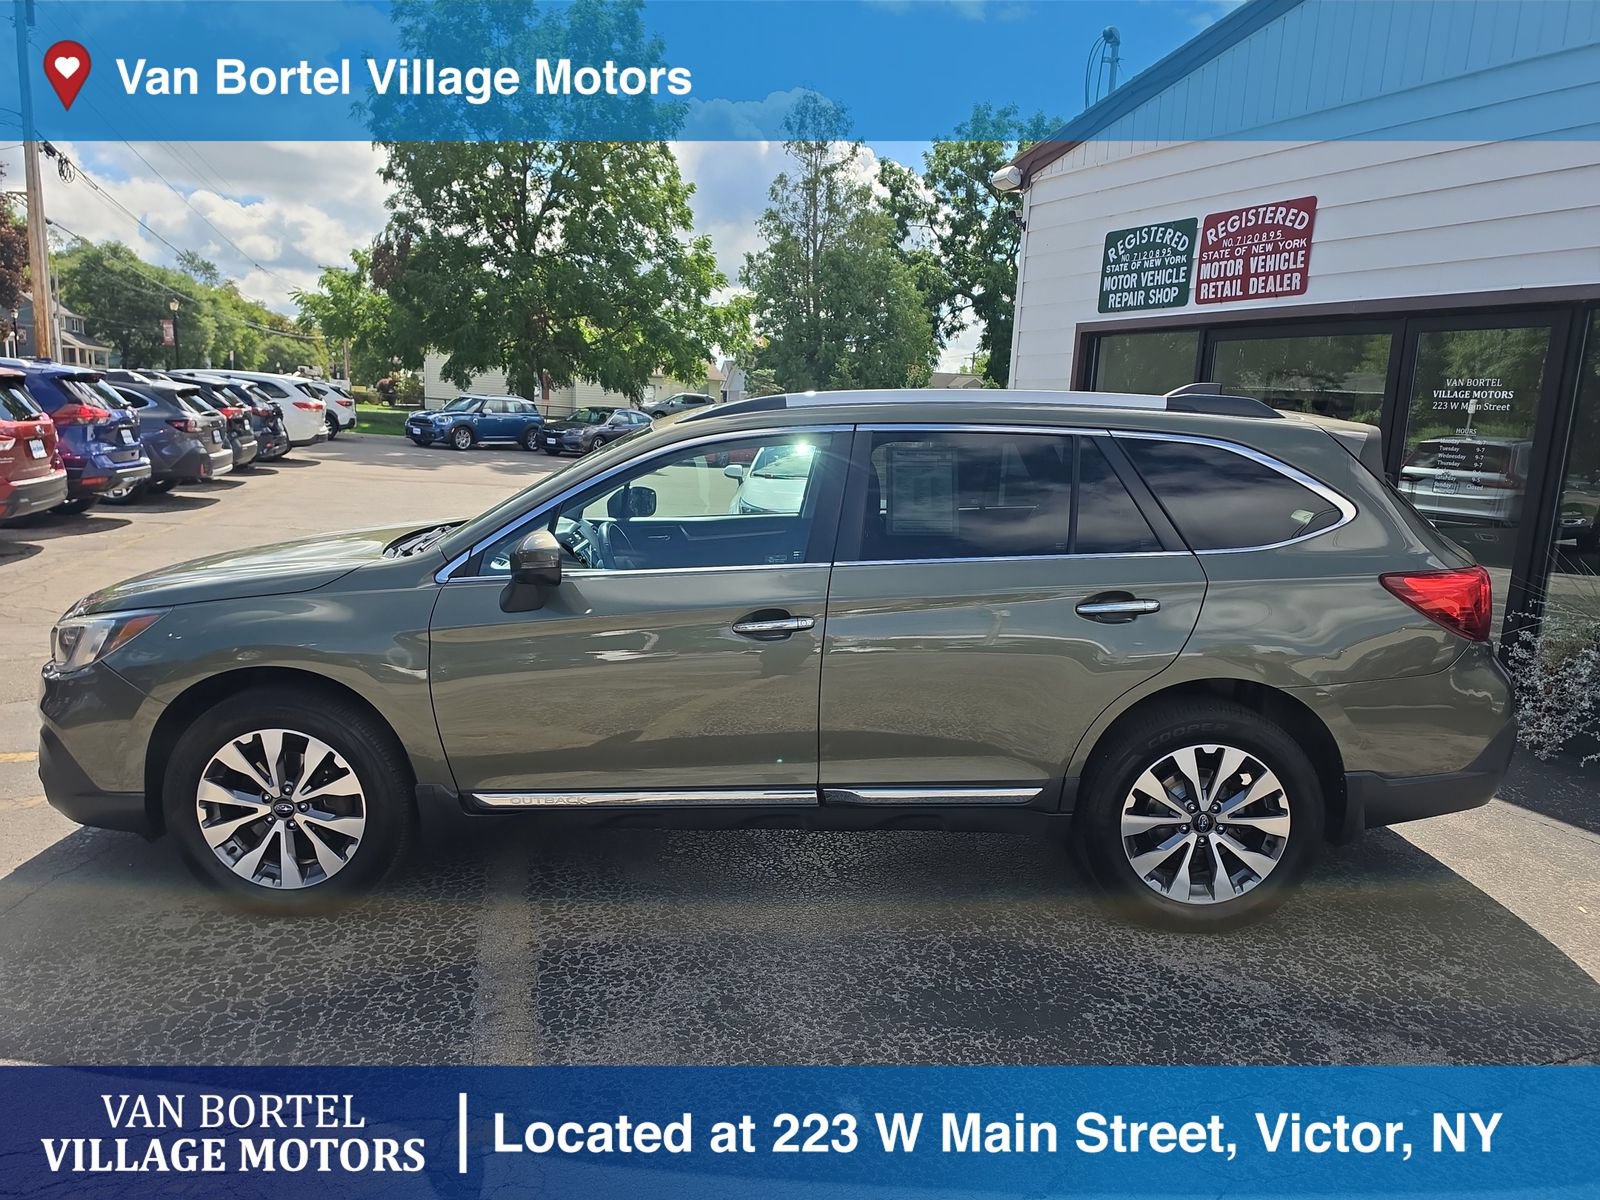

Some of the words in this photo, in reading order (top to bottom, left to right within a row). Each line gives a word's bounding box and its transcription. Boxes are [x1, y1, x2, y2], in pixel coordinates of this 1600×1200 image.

[1206, 206, 1310, 246] REGISTERED
[1236, 230, 1282, 244] 7120895
[1108, 226, 1189, 263] REGISTERED
[1134, 248, 1172, 260] 7120895
[1202, 249, 1230, 261] STATE
[1234, 246, 1248, 257] OF
[1252, 242, 1274, 254] NEW
[1278, 238, 1307, 250] YORK
[1106, 263, 1128, 273] STATE
[1131, 261, 1141, 270] OF
[1144, 258, 1161, 268] NEW
[1165, 255, 1187, 265] YORK
[1200, 258, 1244, 280] MOTOR
[1250, 250, 1306, 274] VEHICLE
[1104, 273, 1137, 292] MOTOR
[1141, 266, 1187, 287] VEHICLE
[1200, 279, 1244, 300] RETAIL
[1249, 273, 1301, 295] DEALER
[1108, 291, 1145, 308] REPAIR
[1149, 287, 1179, 304] SHOP
[1466, 378, 1502, 386] BORTEL
[1433, 390, 1470, 398] VILLAGE
[1472, 390, 1514, 398] MOTORS
[1148, 722, 1228, 749] COOPER
[510, 796, 588, 805] OUTBACK
